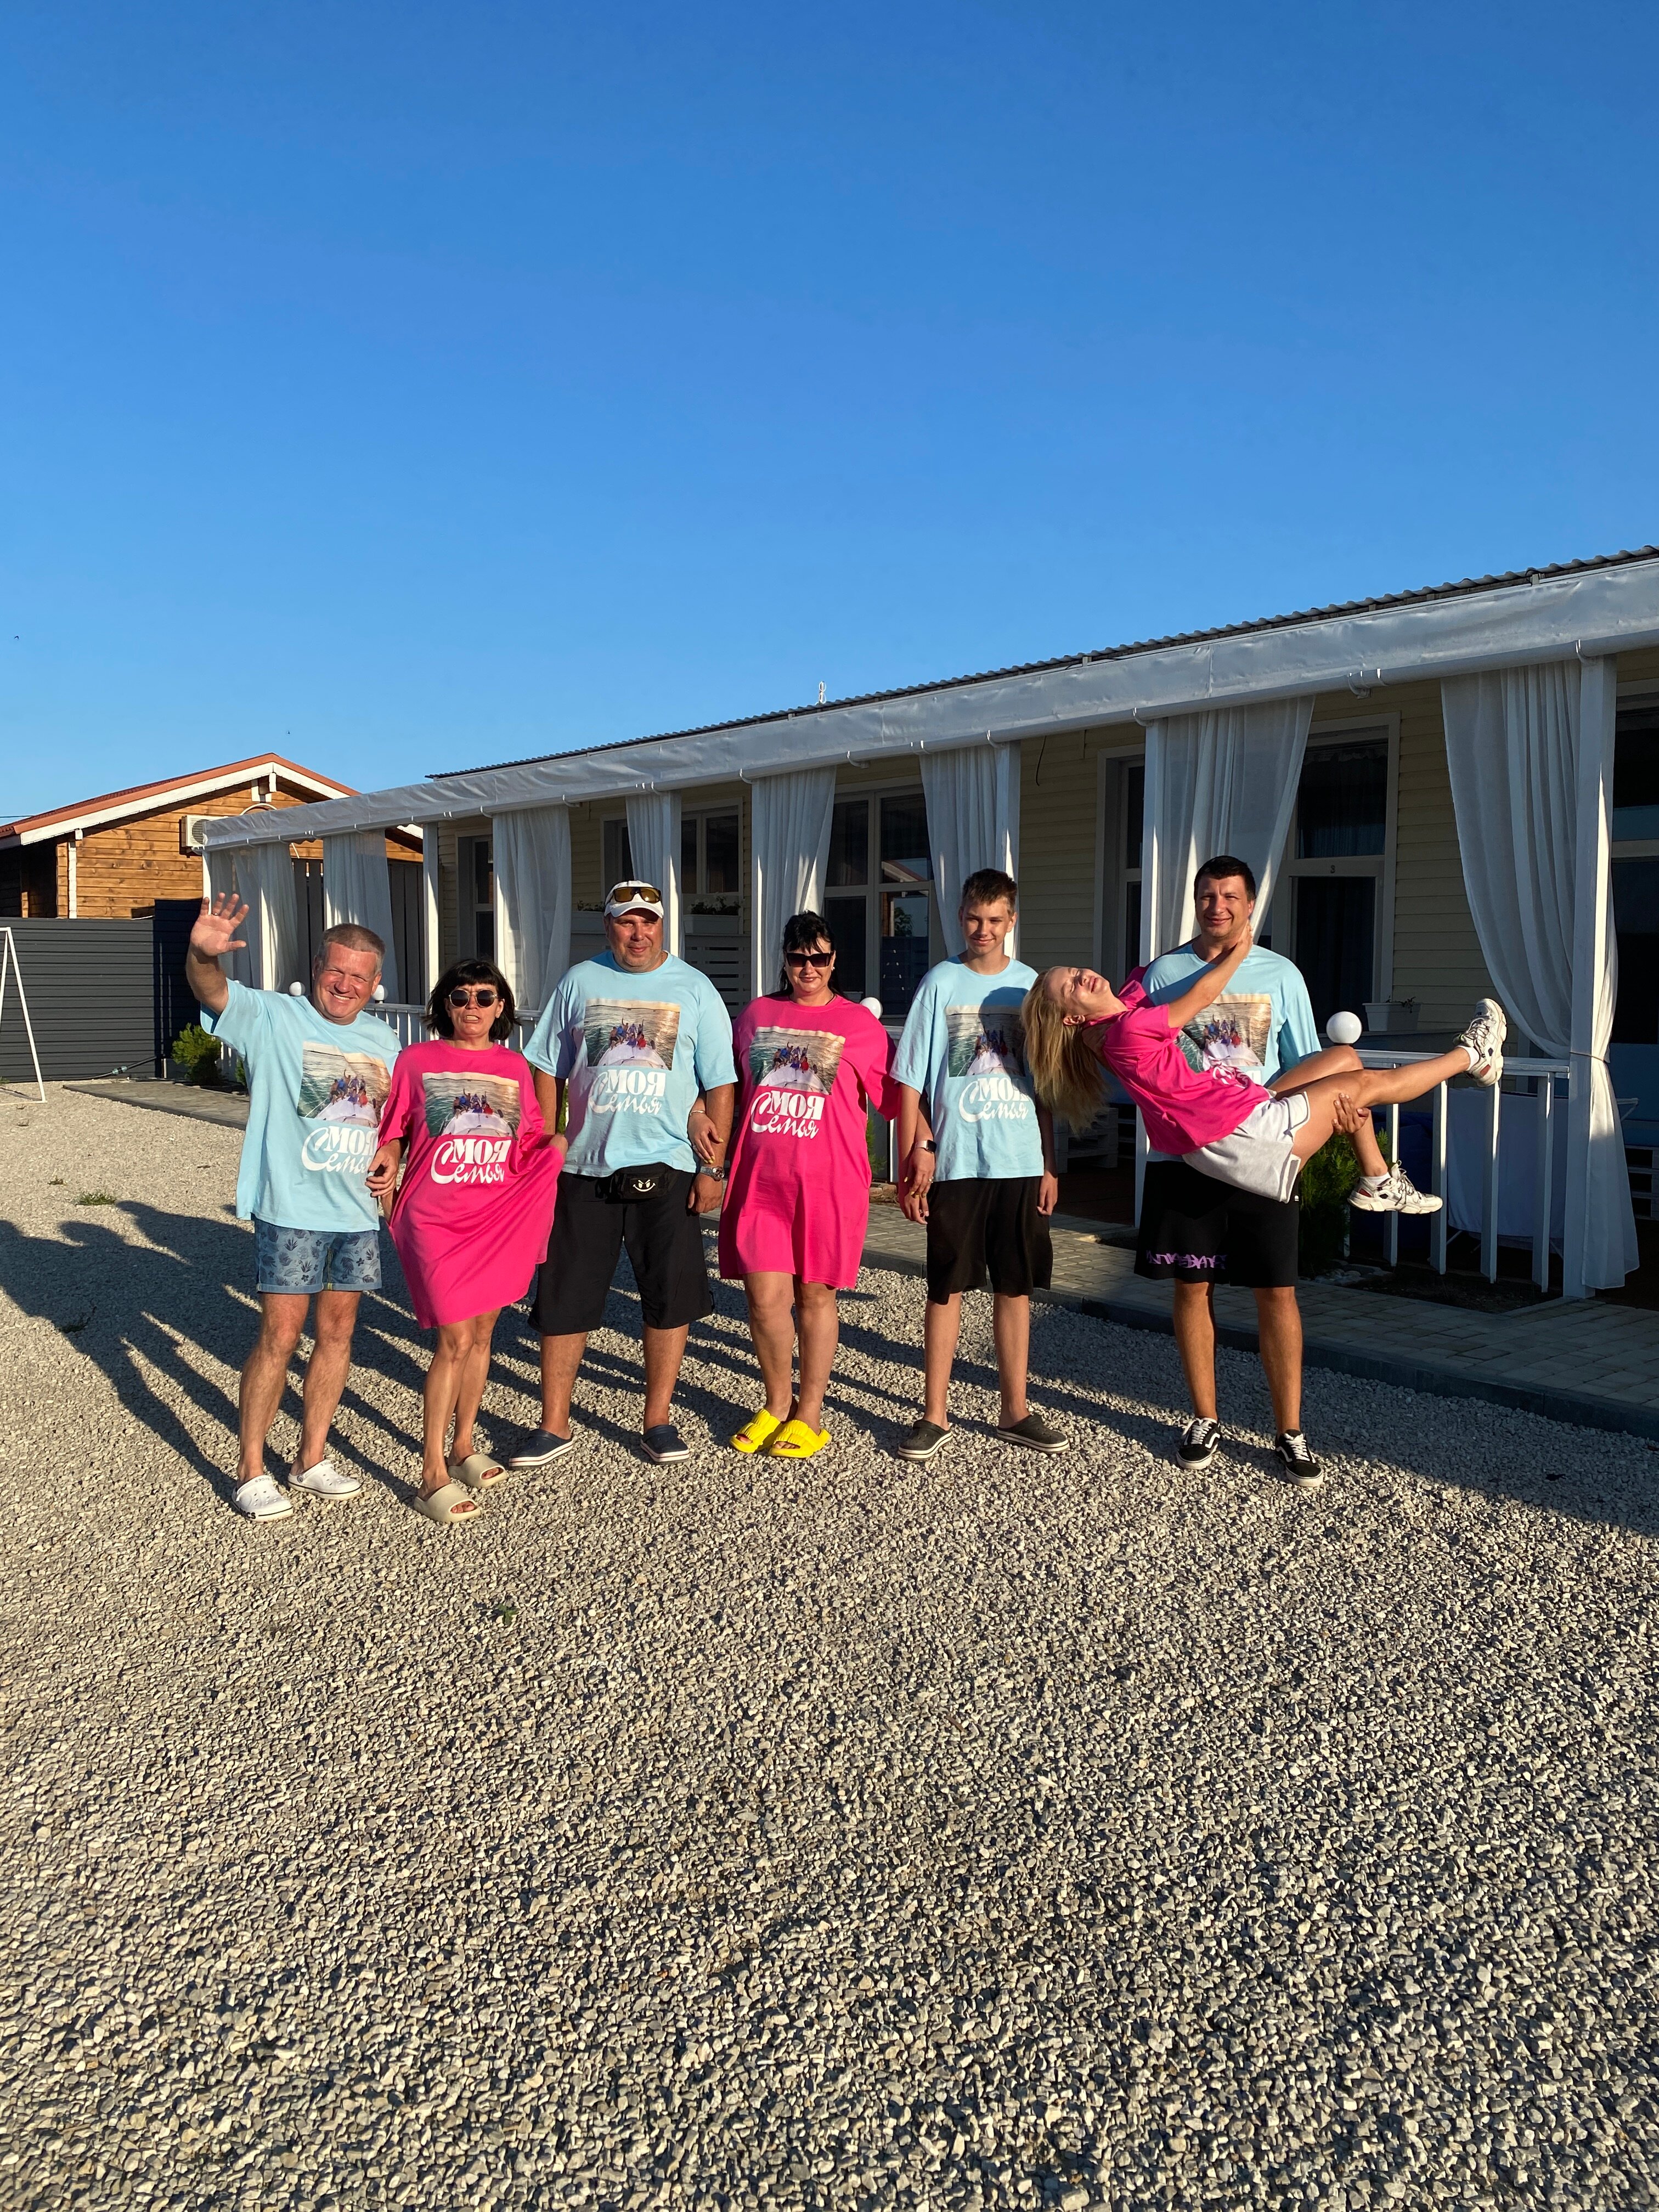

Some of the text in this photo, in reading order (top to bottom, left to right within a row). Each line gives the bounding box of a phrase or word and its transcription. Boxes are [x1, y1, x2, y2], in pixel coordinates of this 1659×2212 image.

[588, 1071, 662, 1115] Семья
[605, 1069, 666, 1097] МОЯ
[959, 1080, 1029, 1122] Семья
[751, 1092, 819, 1139] Семья
[766, 1090, 825, 1120] МОЯ
[323, 1125, 377, 1156] МОЯ
[449, 1138, 512, 1165] МОЯ
[431, 1141, 505, 1184] Семья
